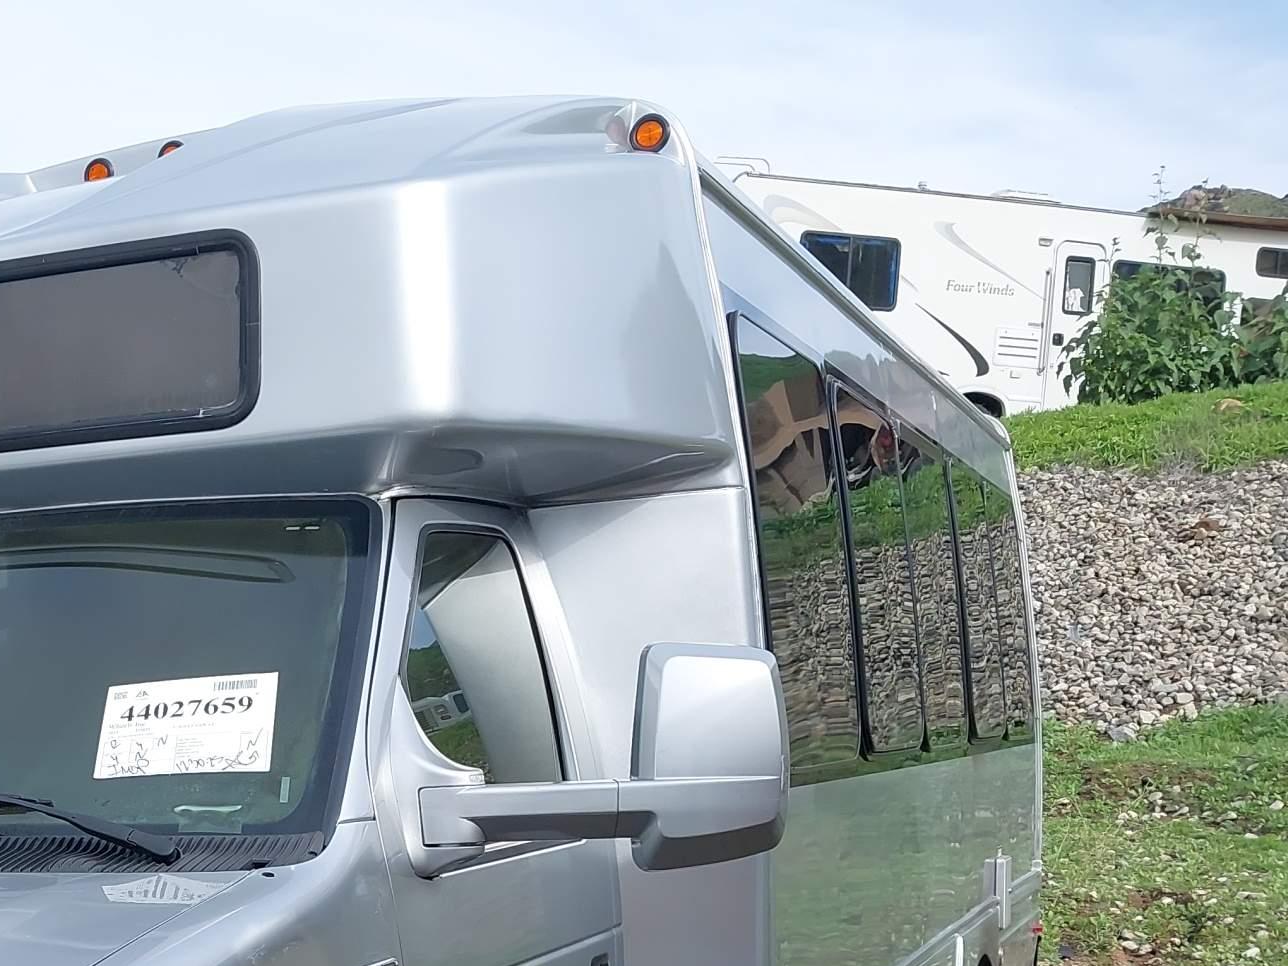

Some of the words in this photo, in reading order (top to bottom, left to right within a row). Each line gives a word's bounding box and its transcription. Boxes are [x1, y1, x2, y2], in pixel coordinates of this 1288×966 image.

[945, 279, 975, 293] Four
[977, 281, 1015, 297] Winds
[120, 695, 253, 722] 44027659
